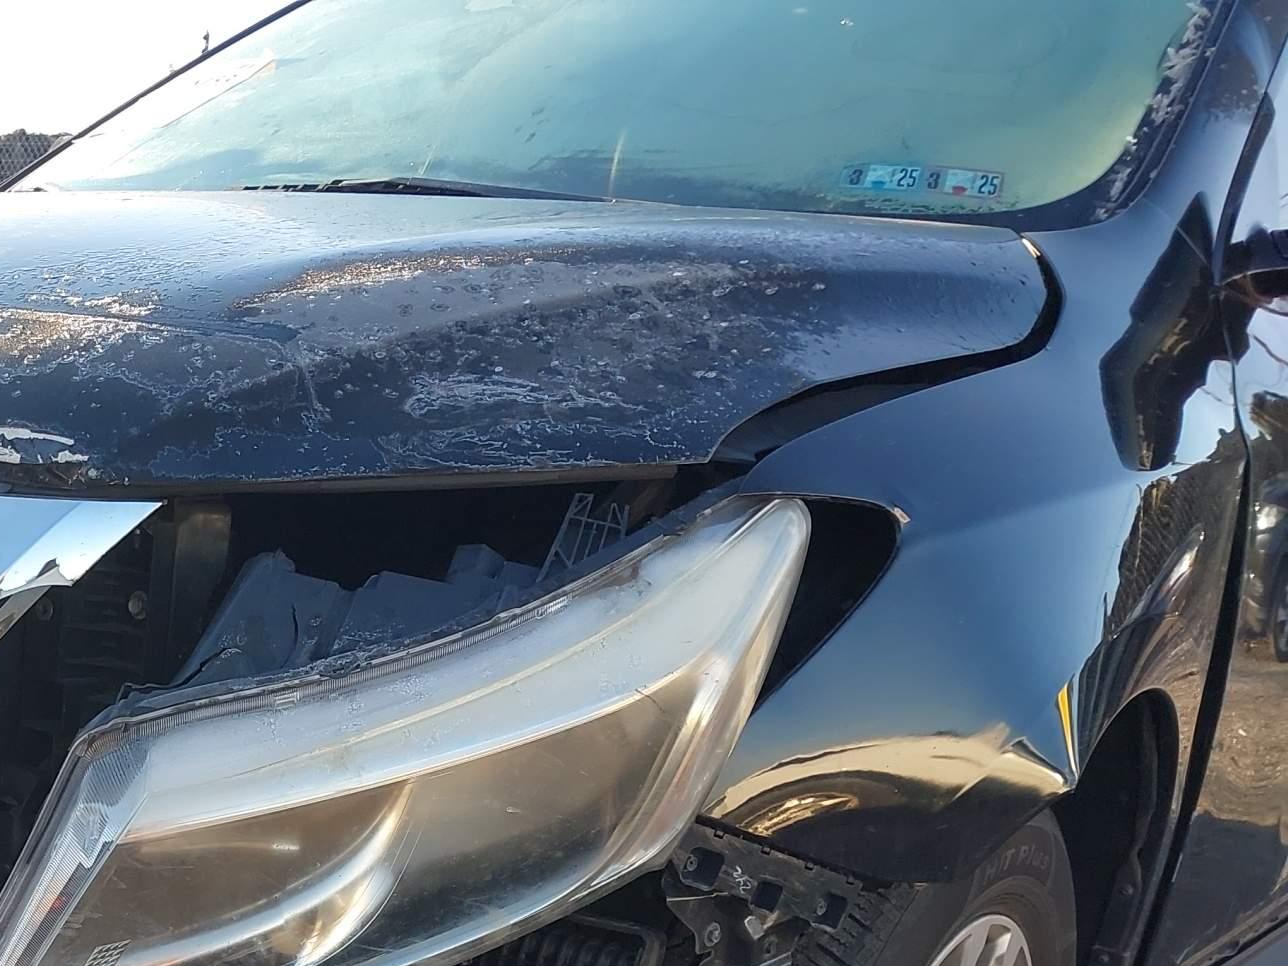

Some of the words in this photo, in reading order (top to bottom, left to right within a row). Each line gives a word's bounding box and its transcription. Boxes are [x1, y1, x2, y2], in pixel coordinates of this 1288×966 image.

[849, 168, 863, 186] 3
[897, 168, 919, 188] 25
[927, 172, 941, 190] 3
[978, 174, 1000, 196] 25
